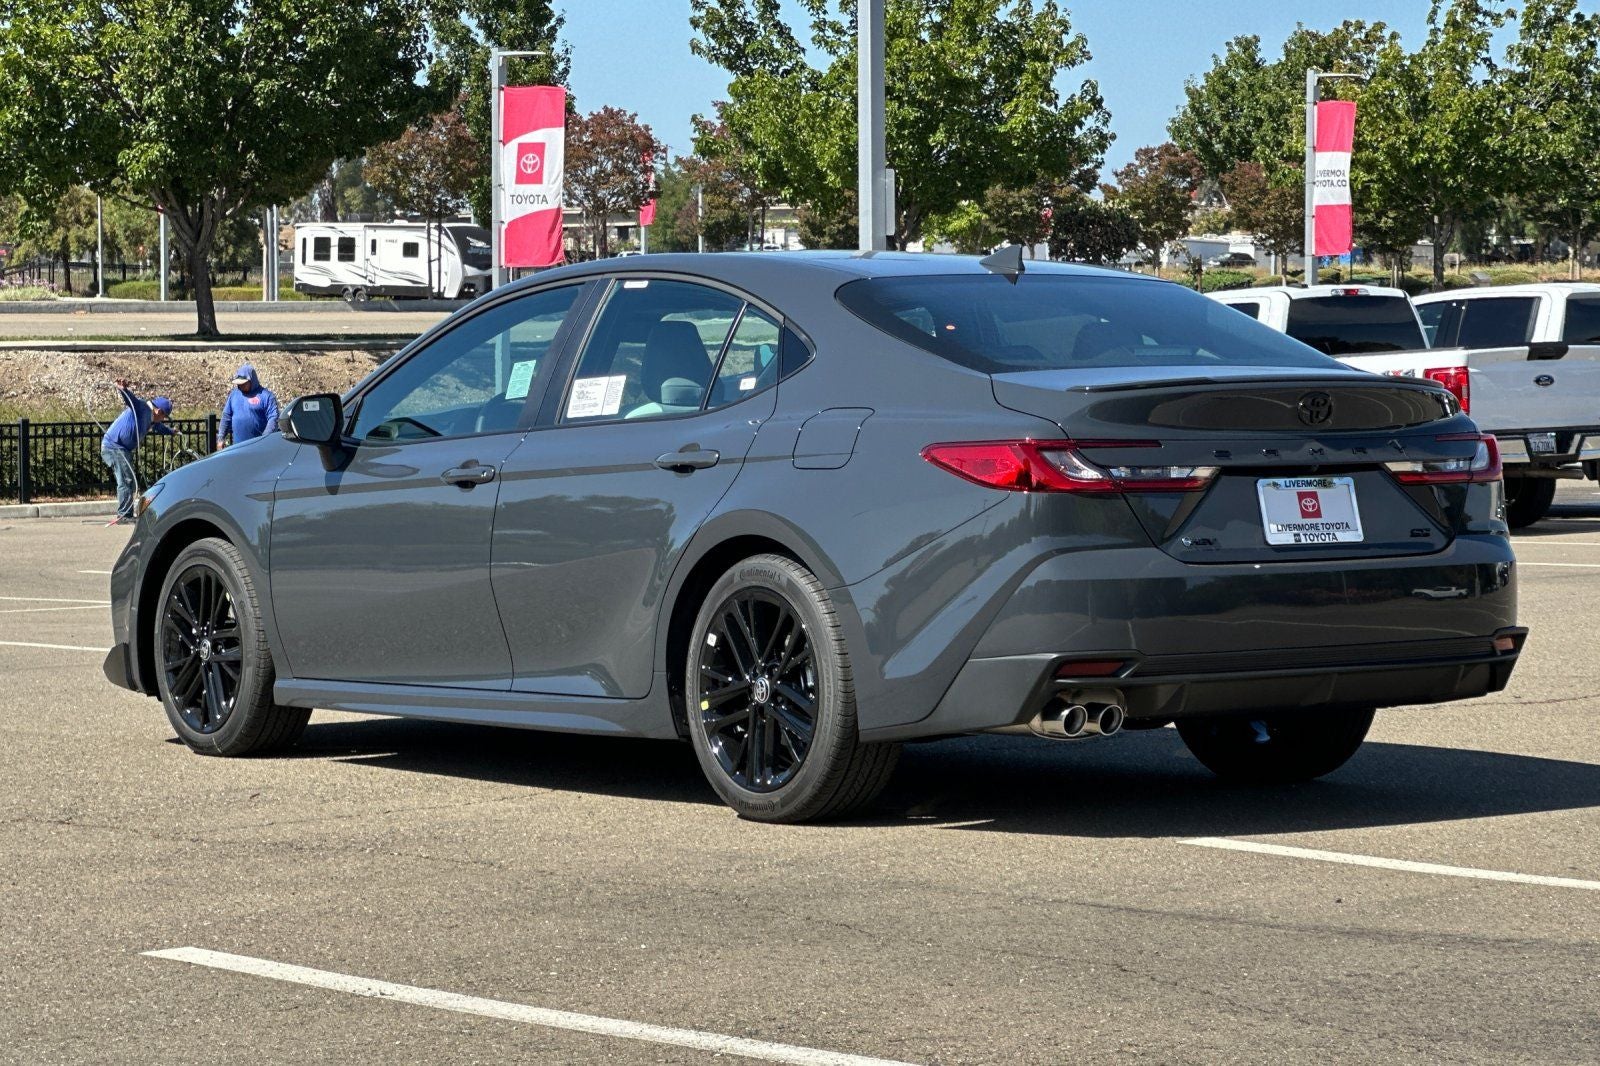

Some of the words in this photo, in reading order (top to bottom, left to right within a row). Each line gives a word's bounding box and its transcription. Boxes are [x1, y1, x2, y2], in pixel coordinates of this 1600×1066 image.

[510, 194, 548, 205] TOYOTA
[1284, 479, 1328, 488] LIVERMORE
[1276, 523, 1320, 532] LIVERMORE
[1321, 522, 1351, 531] TOYOTA
[1303, 533, 1338, 542] TOYOTA
